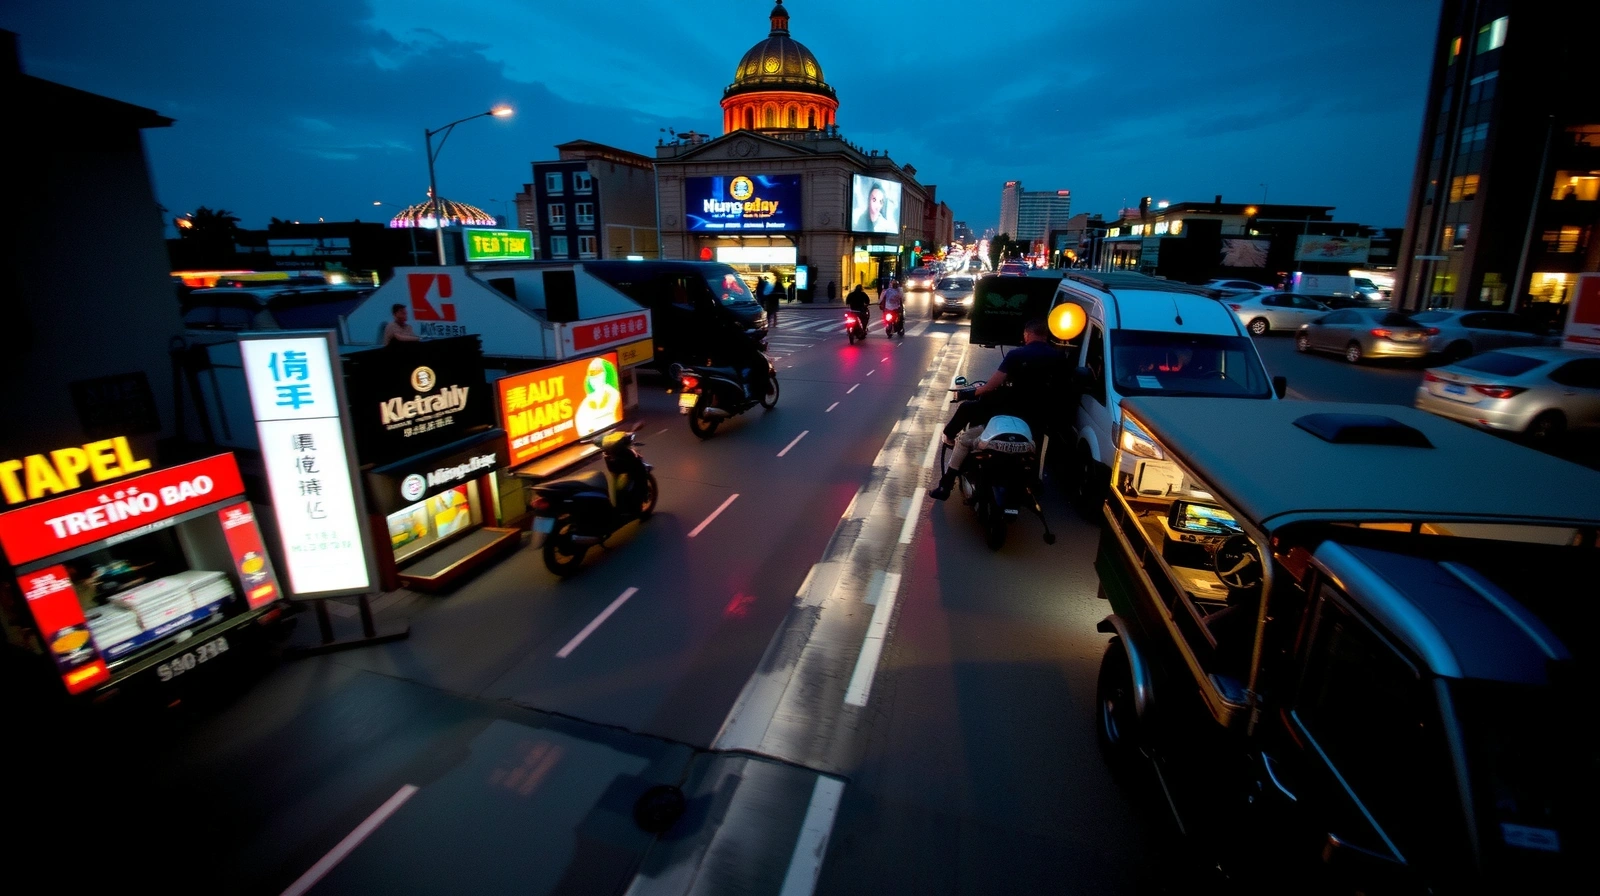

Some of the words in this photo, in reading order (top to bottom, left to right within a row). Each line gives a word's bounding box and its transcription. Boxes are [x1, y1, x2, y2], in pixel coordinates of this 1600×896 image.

[0, 436, 152, 504] TAPEL
[44, 493, 158, 538] TREINO
[159, 475, 214, 506] BAO
